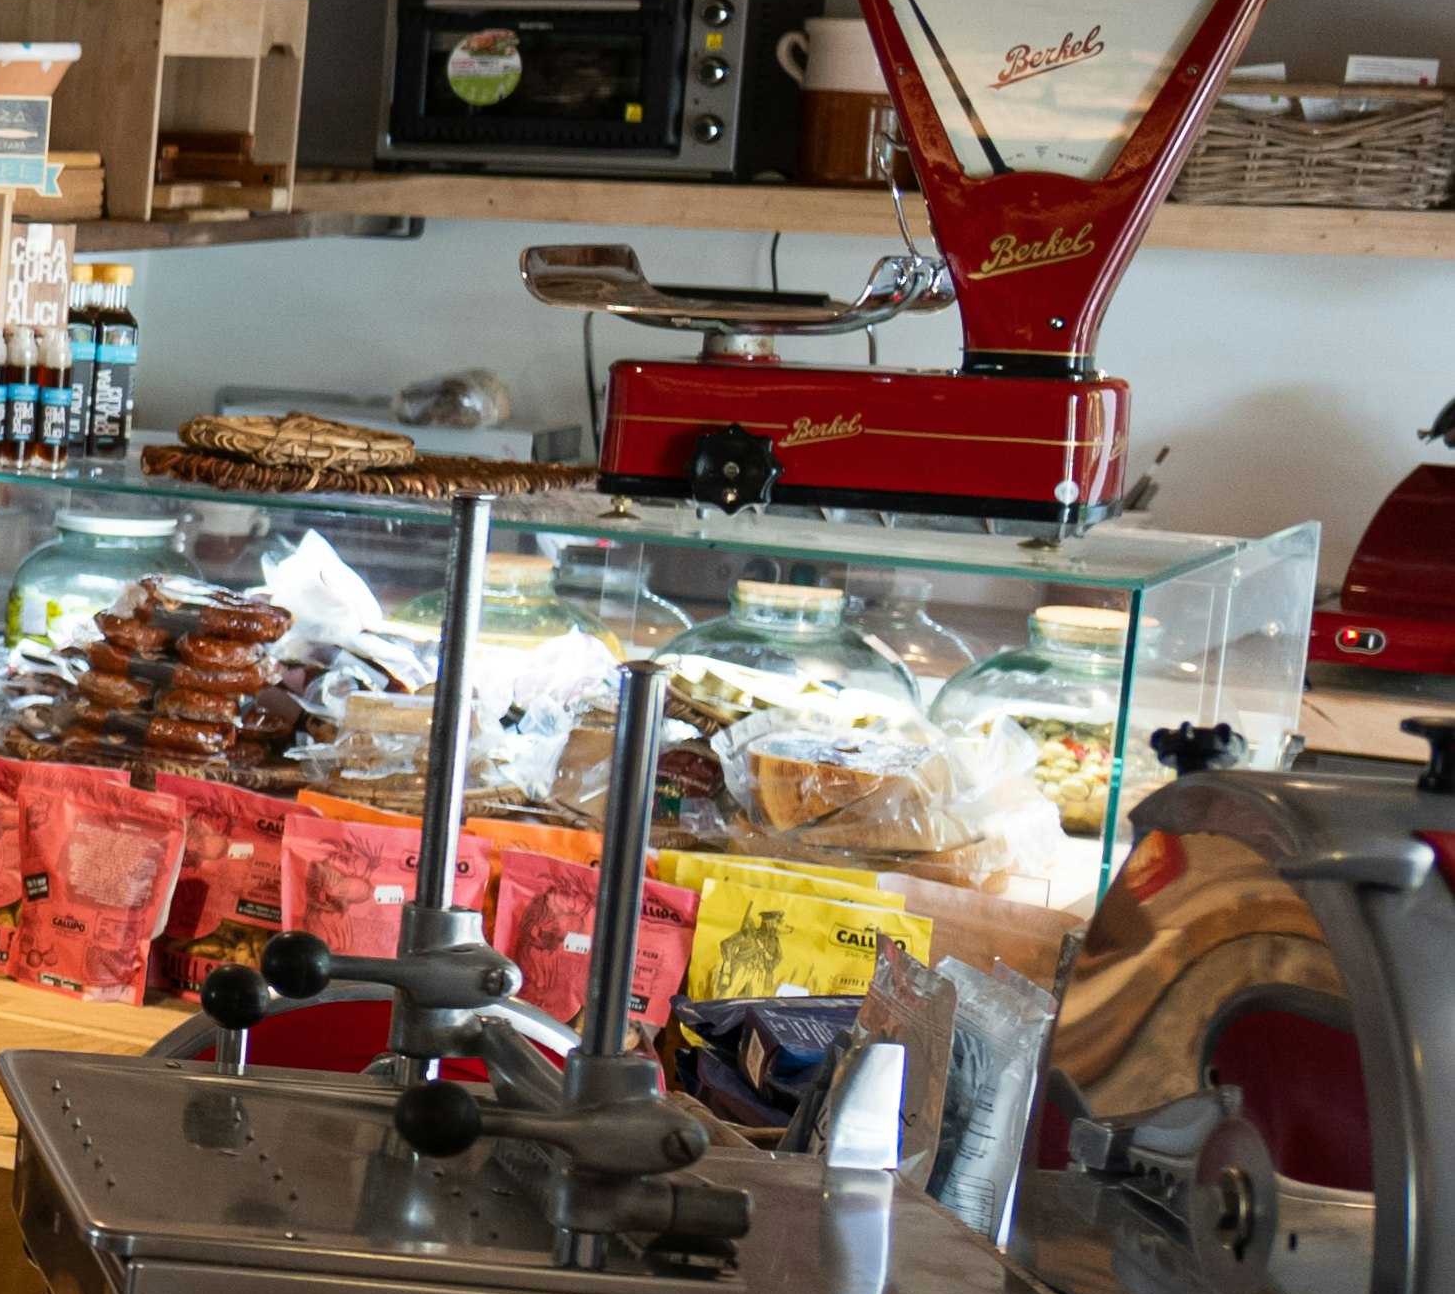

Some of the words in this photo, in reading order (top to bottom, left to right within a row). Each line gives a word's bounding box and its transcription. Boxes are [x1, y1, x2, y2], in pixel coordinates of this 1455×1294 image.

[990, 24, 1104, 86] Berkel
[970, 223, 1095, 279] Berkel
[13, 262, 67, 284] TURA
[7, 281, 29, 306] DI
[6, 302, 59, 327] ALICI
[780, 413, 862, 447] Berkel
[835, 926, 908, 954] CALLO
